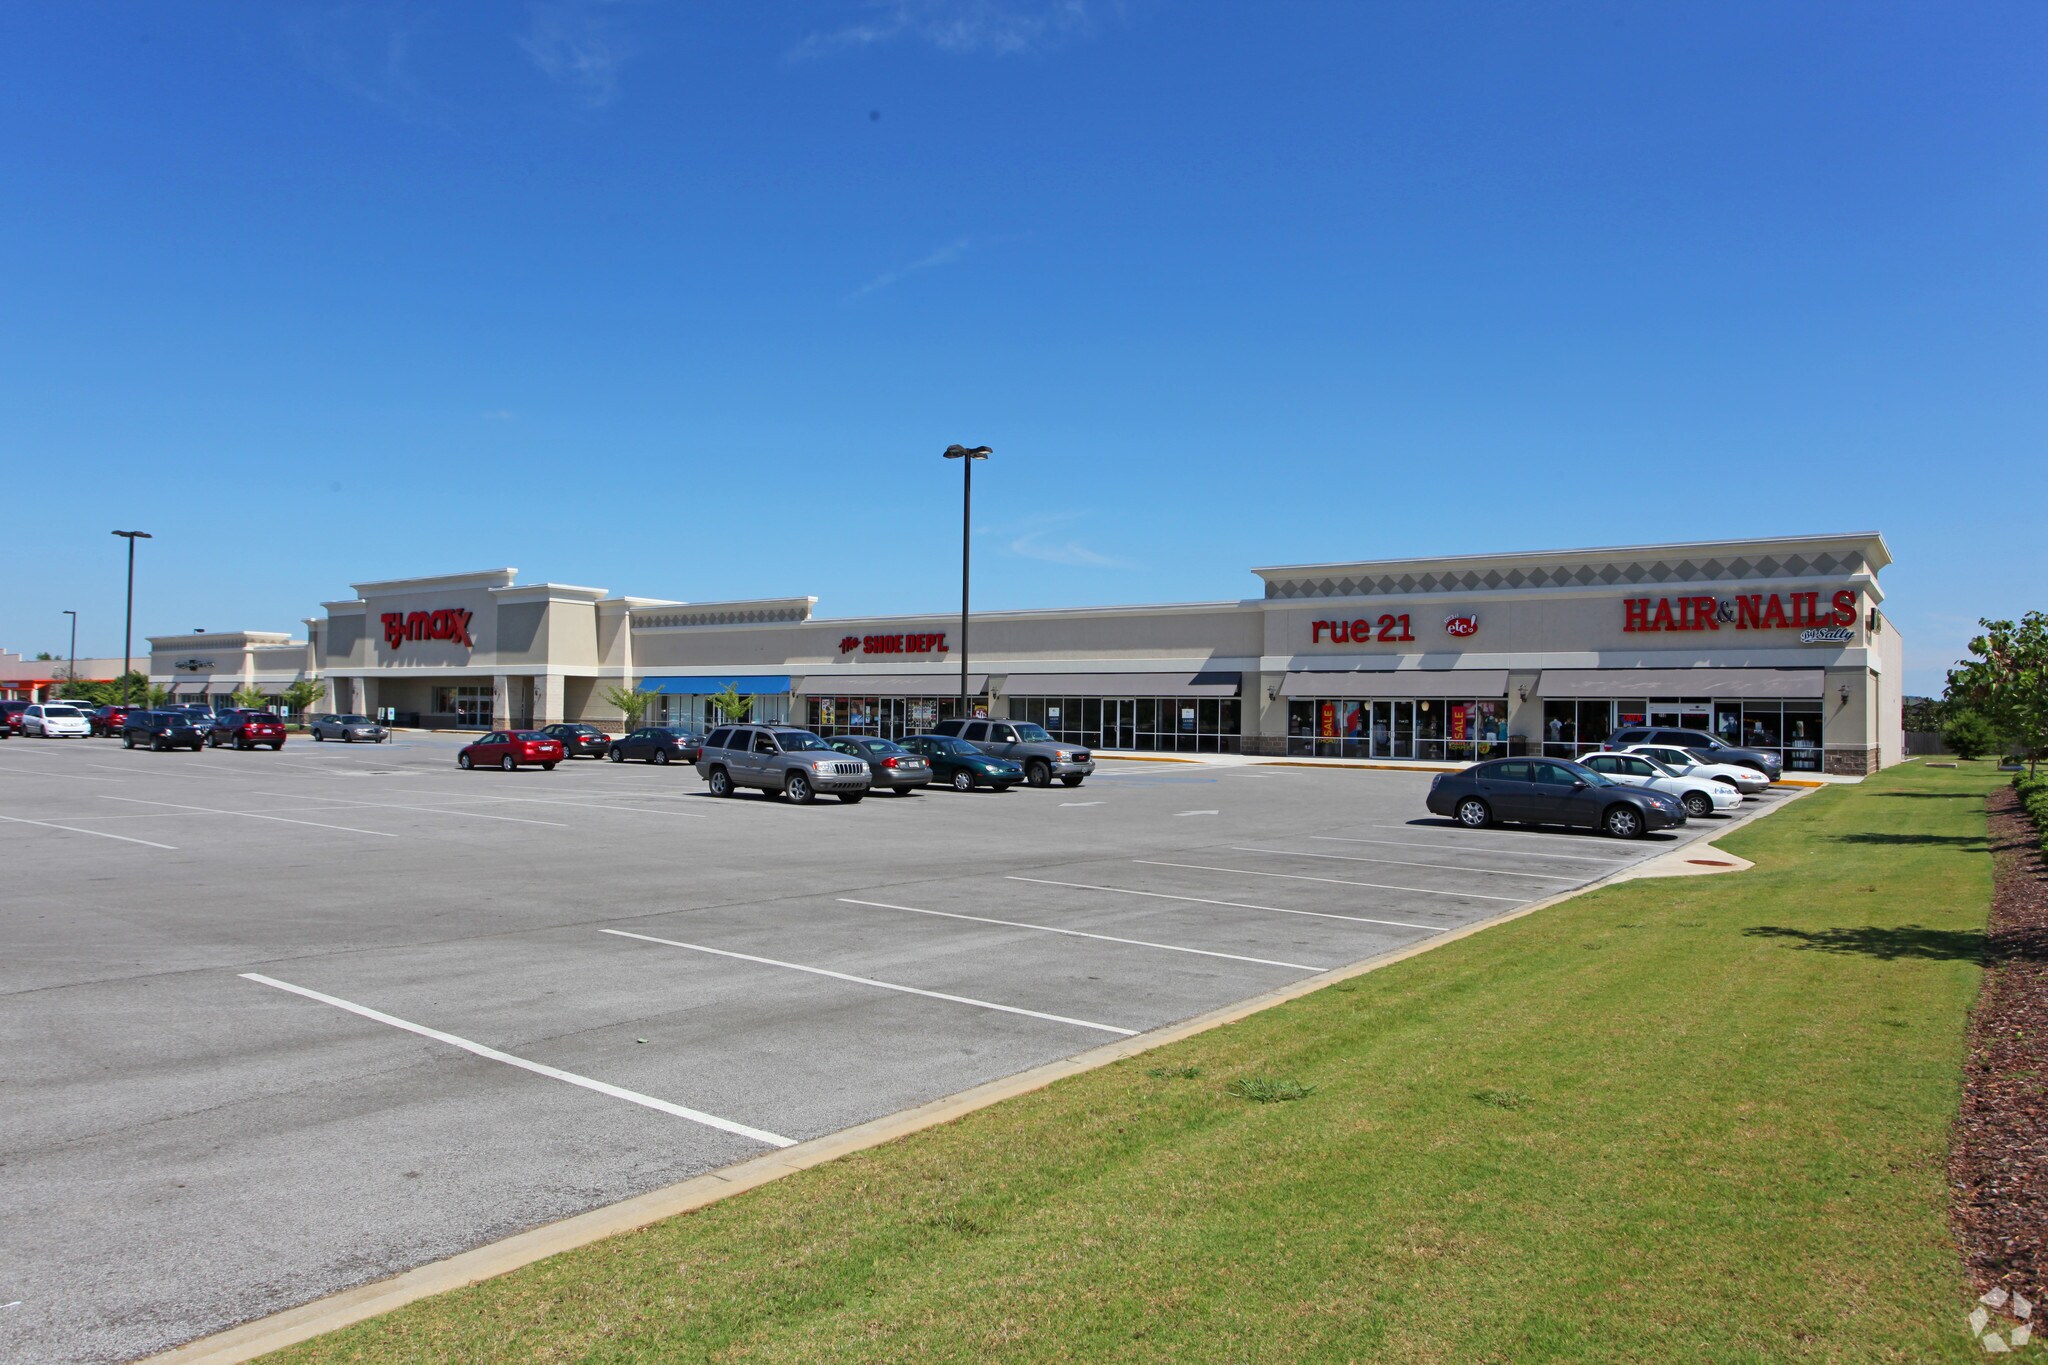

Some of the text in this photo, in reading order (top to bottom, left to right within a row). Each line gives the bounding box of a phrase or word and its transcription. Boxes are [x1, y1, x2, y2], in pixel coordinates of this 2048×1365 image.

[1312, 614, 1415, 643] rue 21
[1816, 627, 1856, 642] Sally
[863, 635, 904, 654] SHOE
[1323, 710, 1333, 737] SALE
[1454, 711, 1464, 740] SALE
